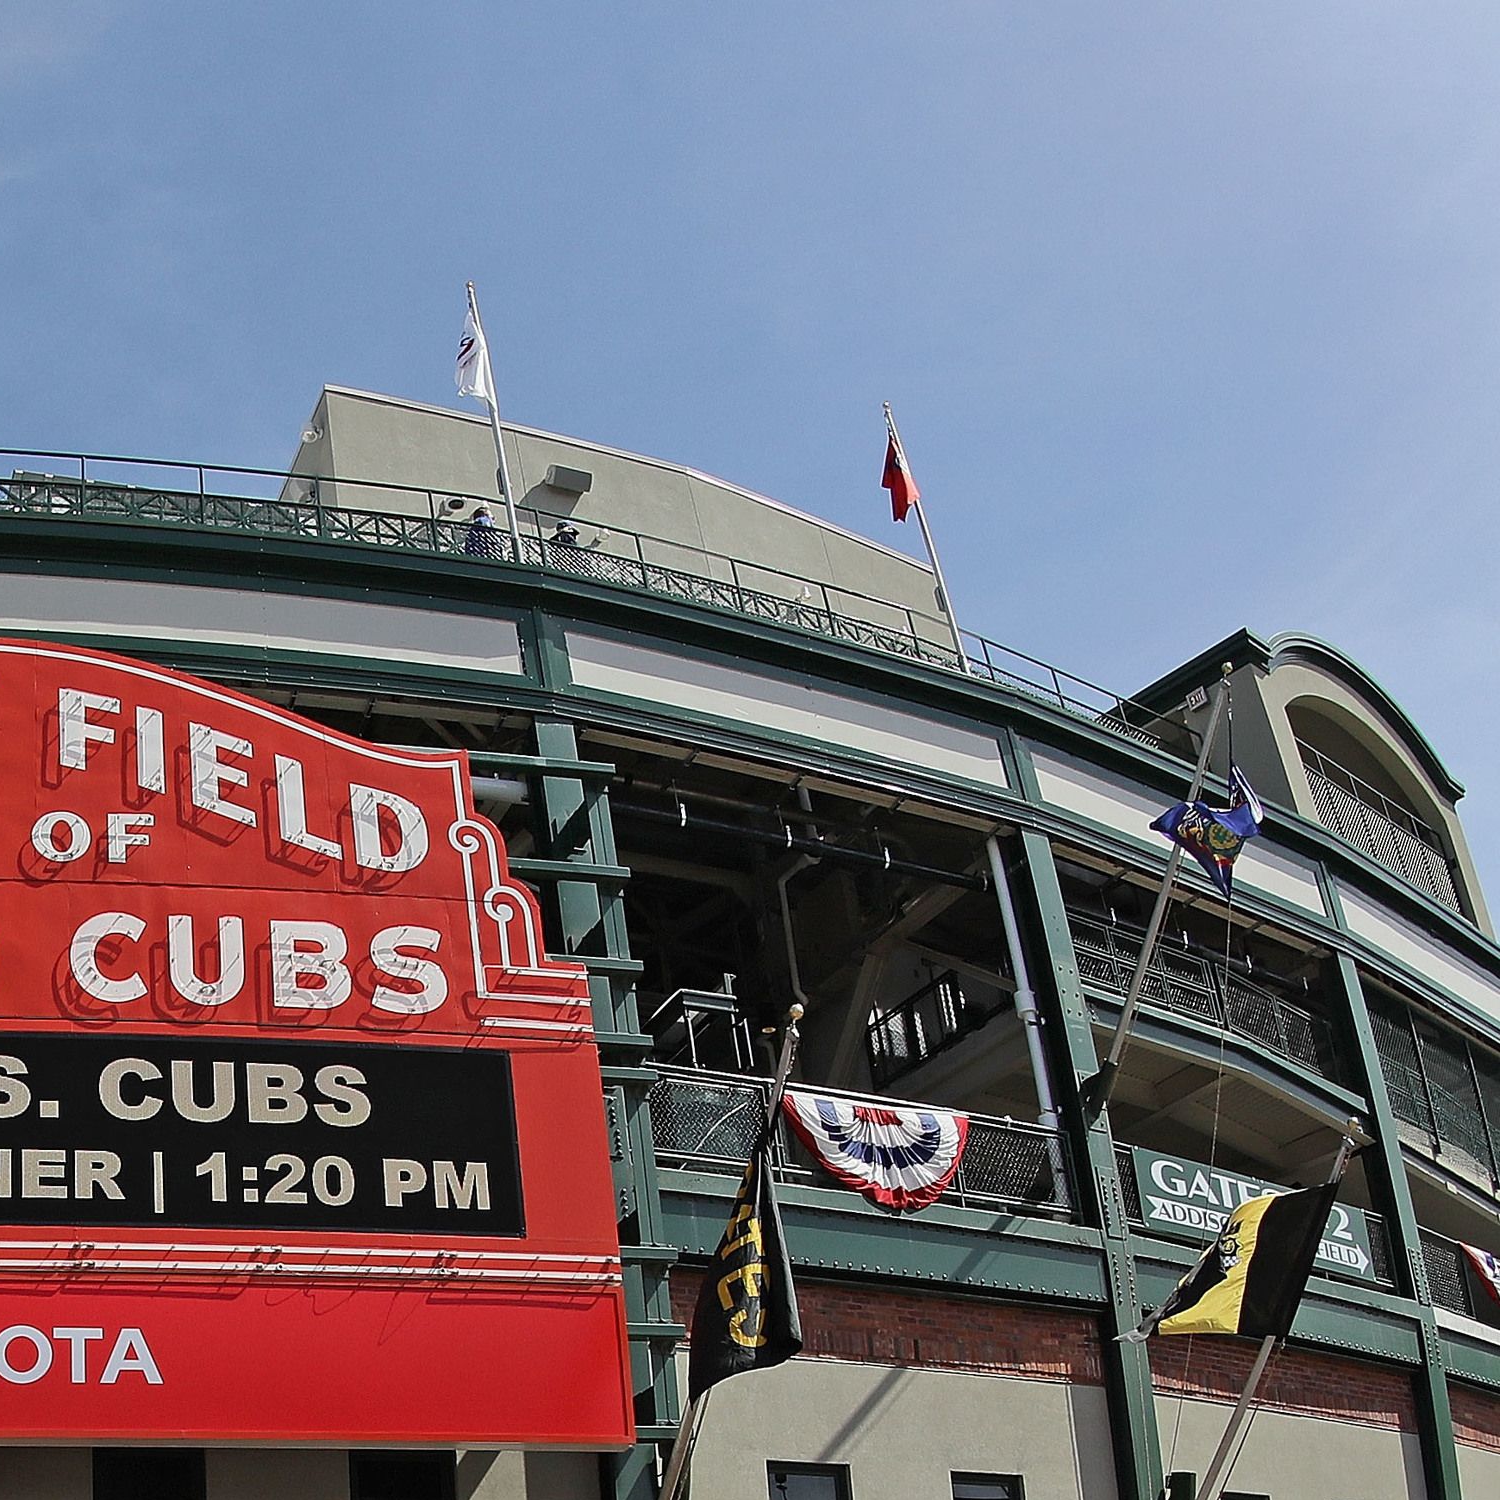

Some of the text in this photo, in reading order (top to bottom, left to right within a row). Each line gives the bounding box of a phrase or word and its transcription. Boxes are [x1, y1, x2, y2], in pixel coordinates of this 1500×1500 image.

[57, 687, 430, 873] FIELD
[31, 810, 156, 863] OF
[68, 911, 449, 1014] CUBS
[97, 1058, 372, 1126] CUBS
[194, 1153, 356, 1205] 1:20
[382, 1158, 491, 1211] PM
